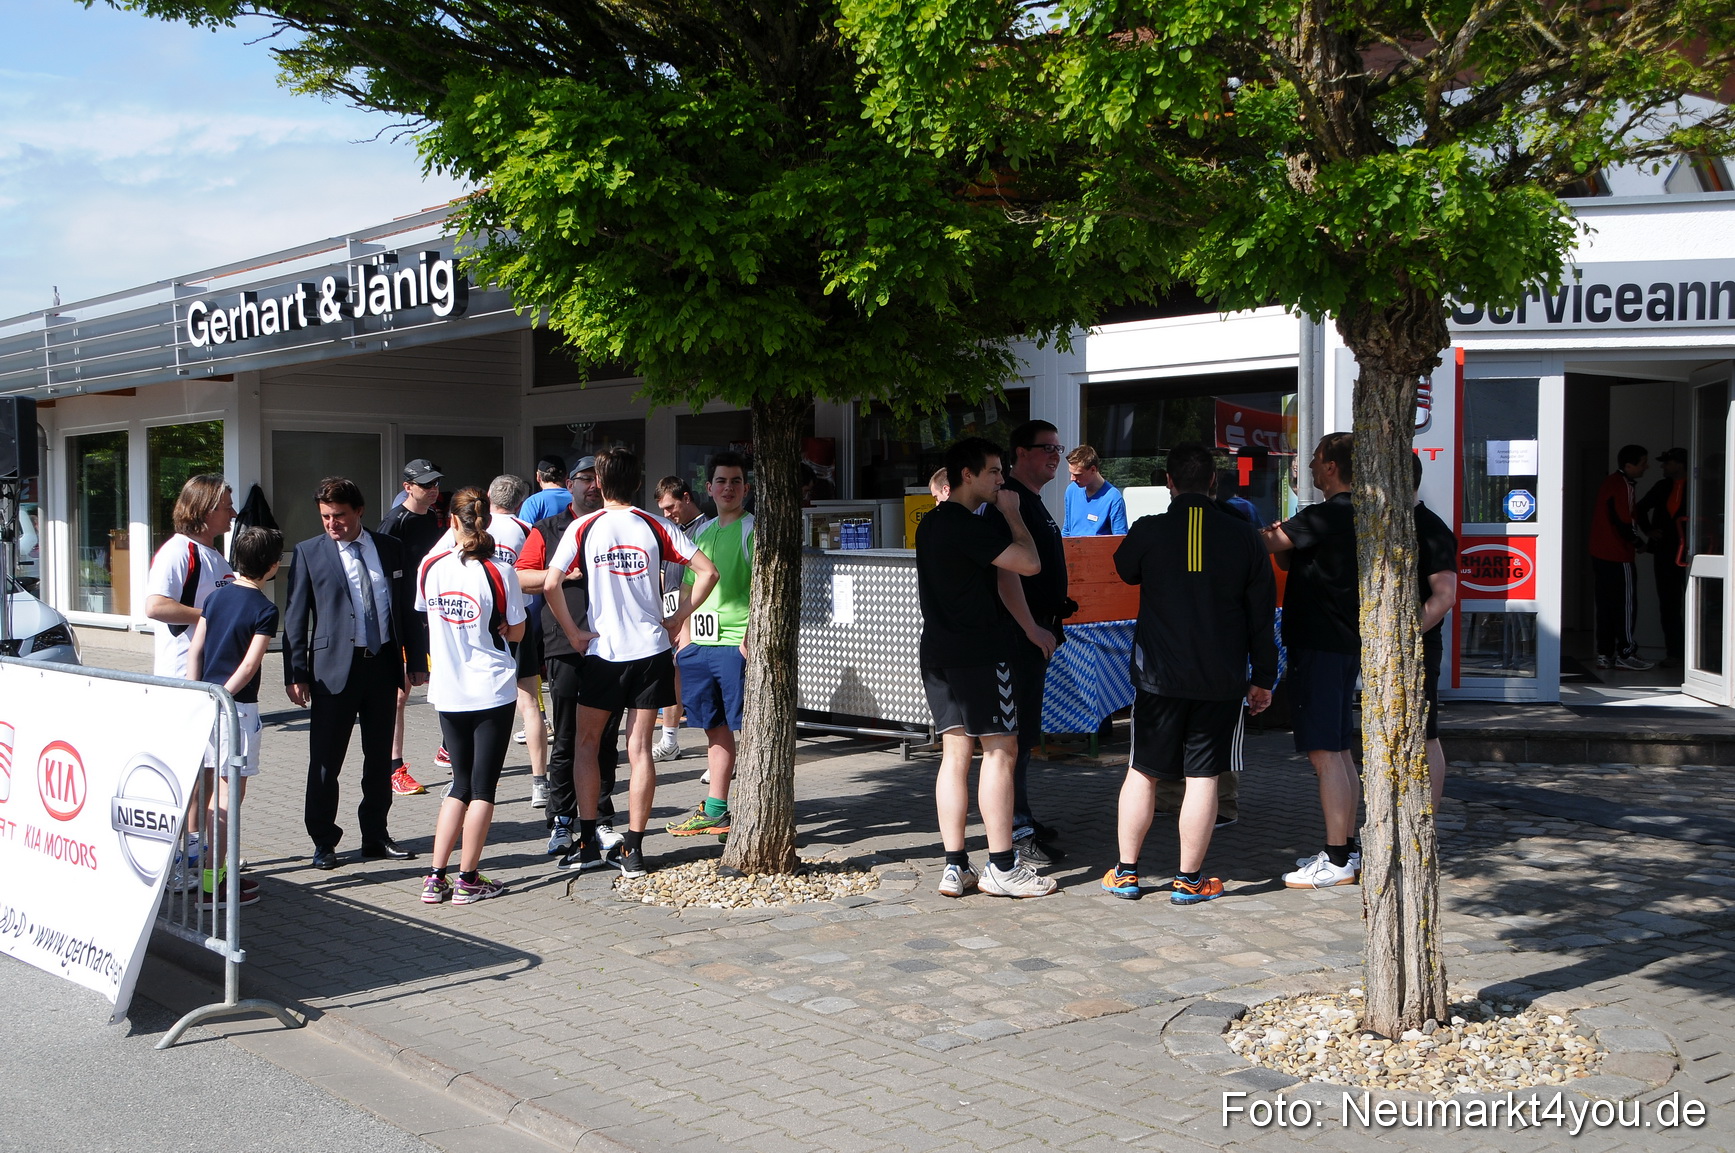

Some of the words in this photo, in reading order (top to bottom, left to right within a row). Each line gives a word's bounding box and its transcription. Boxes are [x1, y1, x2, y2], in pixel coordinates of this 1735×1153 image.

[186, 282, 308, 348] Gerhart
[319, 275, 343, 324] &
[353, 251, 456, 317] Jänig
[593, 552, 638, 564] GERHART
[428, 597, 469, 609] GERHART
[694, 613, 714, 637] 130
[45, 757, 78, 806] KIA
[24, 823, 41, 853] KIA
[44, 831, 98, 871] MOTORS
